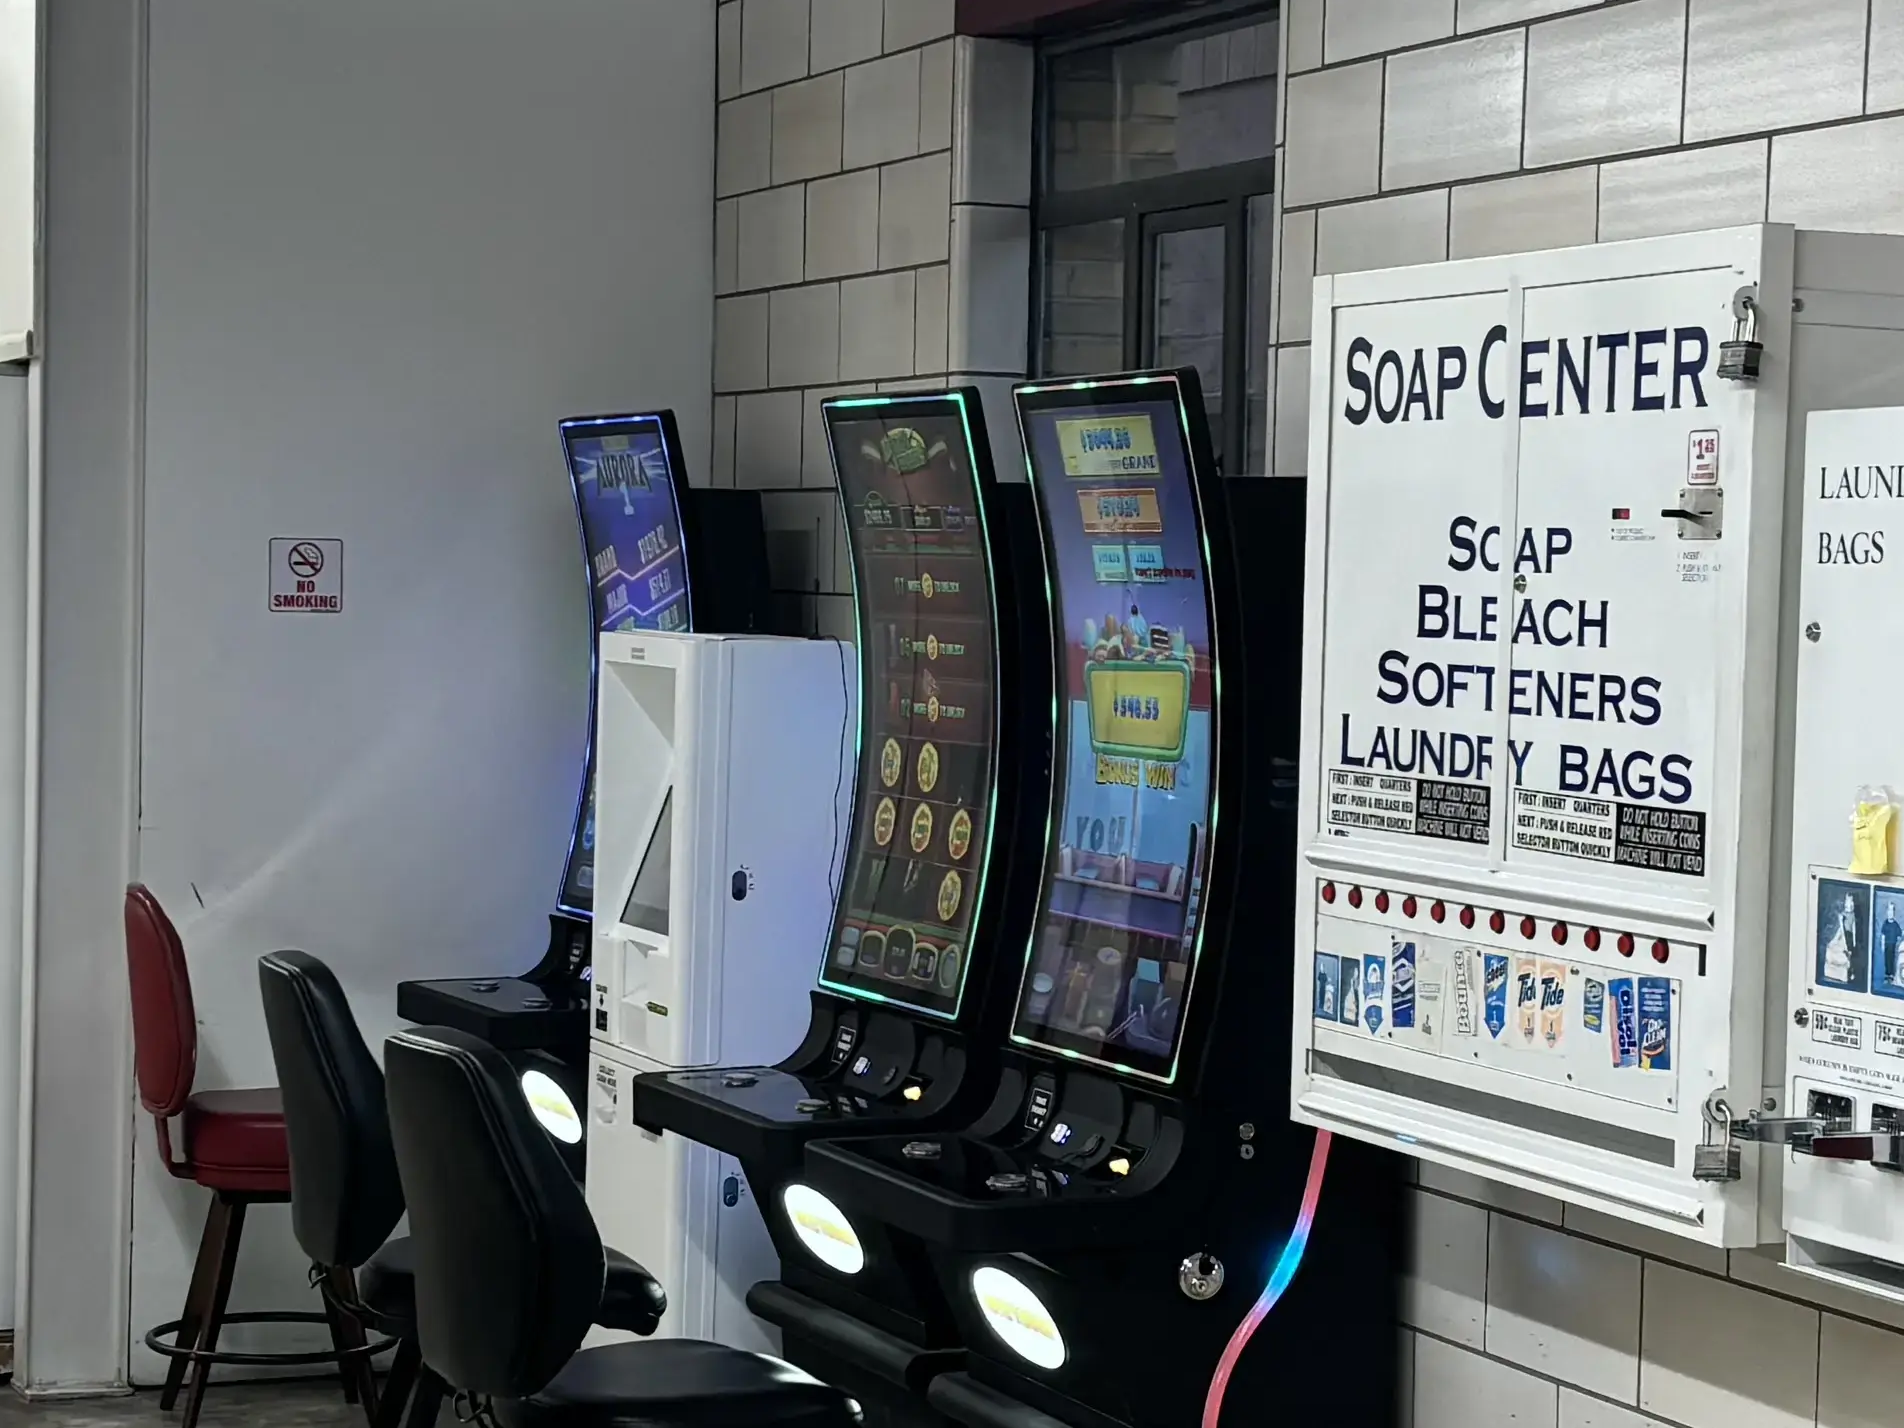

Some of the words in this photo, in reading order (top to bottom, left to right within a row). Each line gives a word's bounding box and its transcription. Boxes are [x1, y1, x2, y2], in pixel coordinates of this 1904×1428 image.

[1345, 336, 1467, 425] SOAP
[1478, 325, 1709, 420] CENTER
[1448, 516, 1572, 573] SOAP
[1817, 531, 1884, 564] BAGS
[274, 594, 338, 608] SMOKING
[296, 580, 315, 593] NO
[1415, 584, 1609, 647] BLEACH
[1377, 650, 1662, 726] SOFTENERS
[1341, 713, 1533, 785] LAUNDRY
[1559, 744, 1693, 804] BAGS
[1542, 795, 1566, 809] INSERT
[1573, 800, 1610, 816] QUARTERS
[1622, 807, 1633, 822] DO
[1650, 811, 1669, 827] HOLD
[1517, 832, 1550, 847] SELECTOR
[1552, 838, 1579, 852] BUTTON
[1580, 842, 1611, 858] QUICKLY
[1540, 817, 1558, 831] PUSH
[1566, 821, 1596, 837] RELEASE
[1599, 827, 1612, 840] RED
[1540, 977, 1565, 1010] Tide
